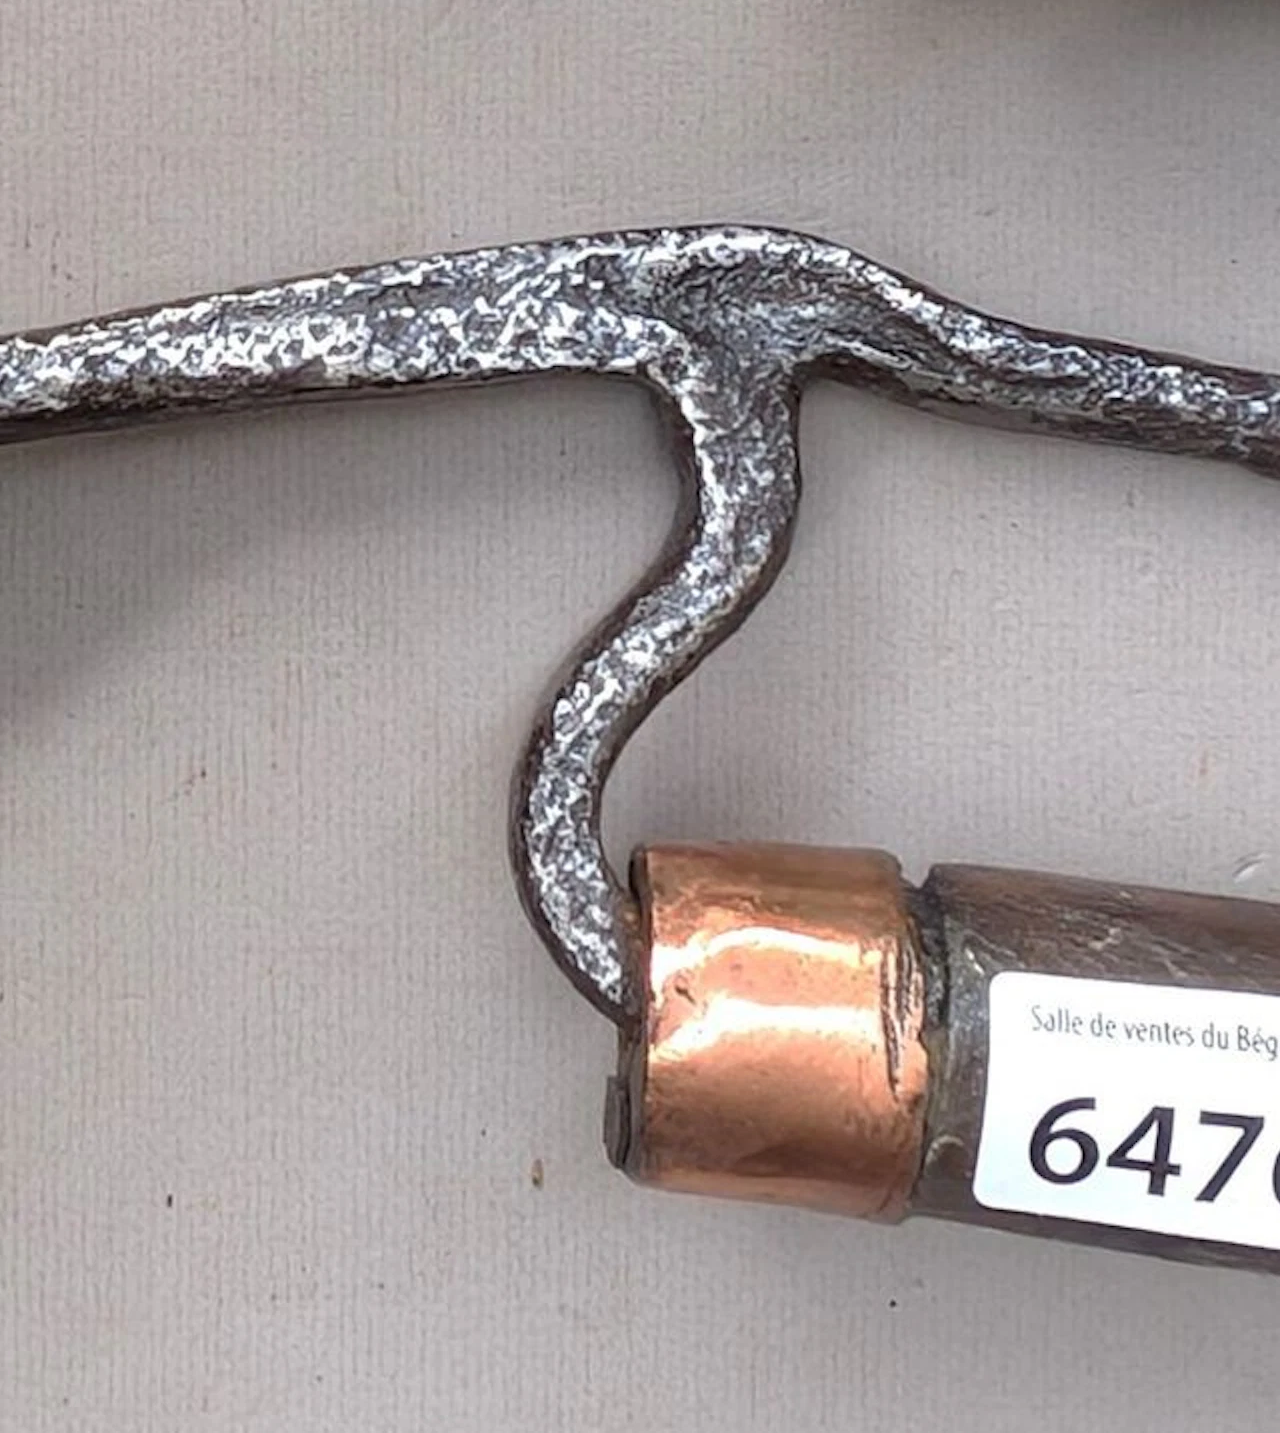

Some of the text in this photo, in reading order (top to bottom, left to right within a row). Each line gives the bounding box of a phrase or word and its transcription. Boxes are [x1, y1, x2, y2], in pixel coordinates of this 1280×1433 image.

[1031, 1004, 1083, 1036] Salle
[1090, 1013, 1117, 1039] de
[1123, 1022, 1195, 1047] ventes
[1202, 1022, 1229, 1050] du
